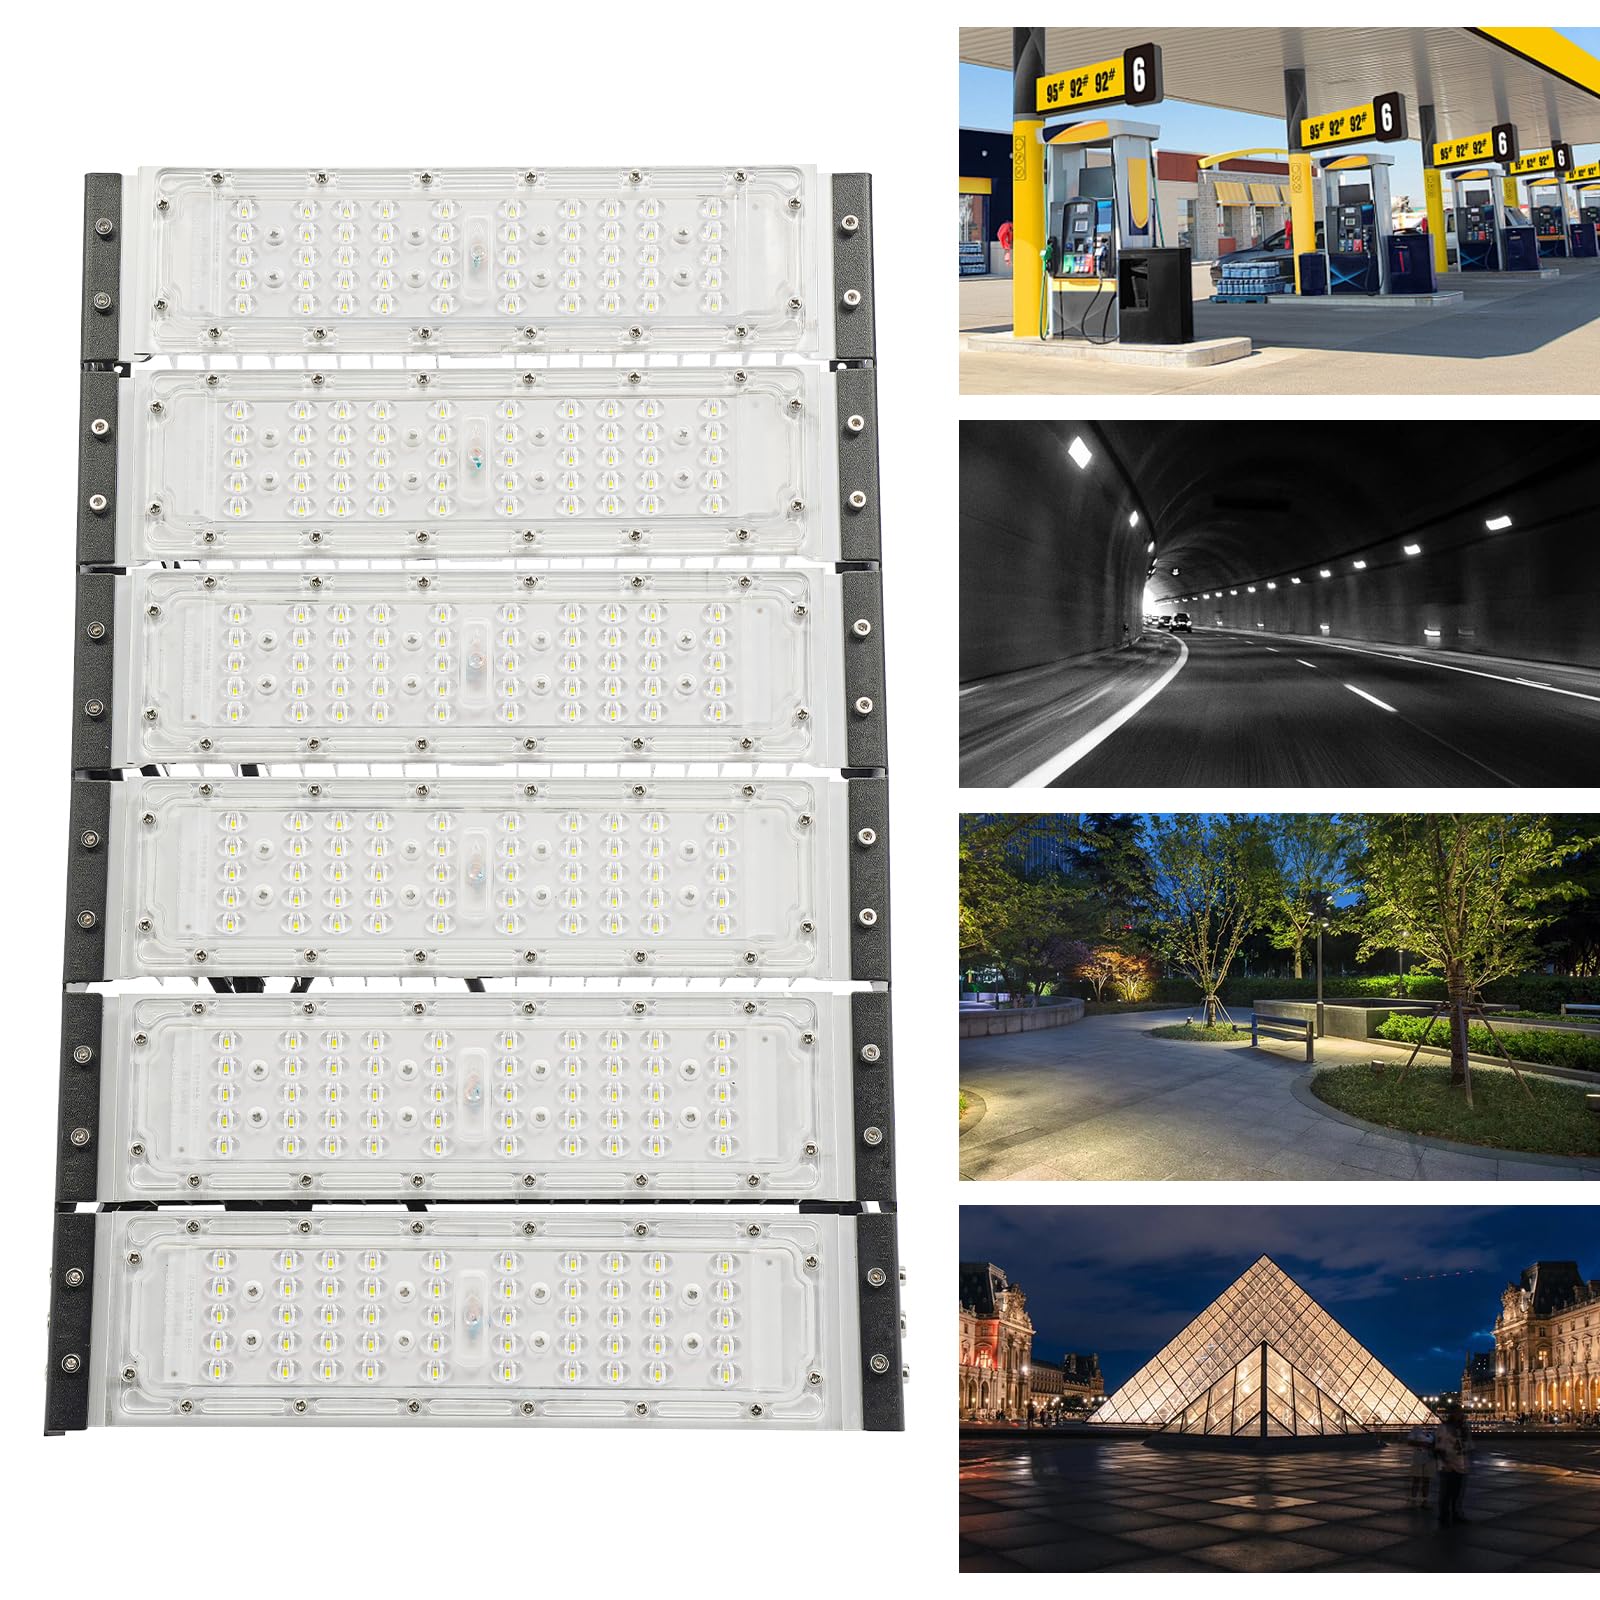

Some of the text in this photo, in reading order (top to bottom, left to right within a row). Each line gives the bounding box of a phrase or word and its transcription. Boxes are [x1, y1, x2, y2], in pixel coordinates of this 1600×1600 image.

[1047, 56, 1146, 103] 95# 92# 92# 6
[1382, 102, 1393, 132] 6
[1498, 131, 1507, 155] 6
[1557, 149, 1565, 166] 6
